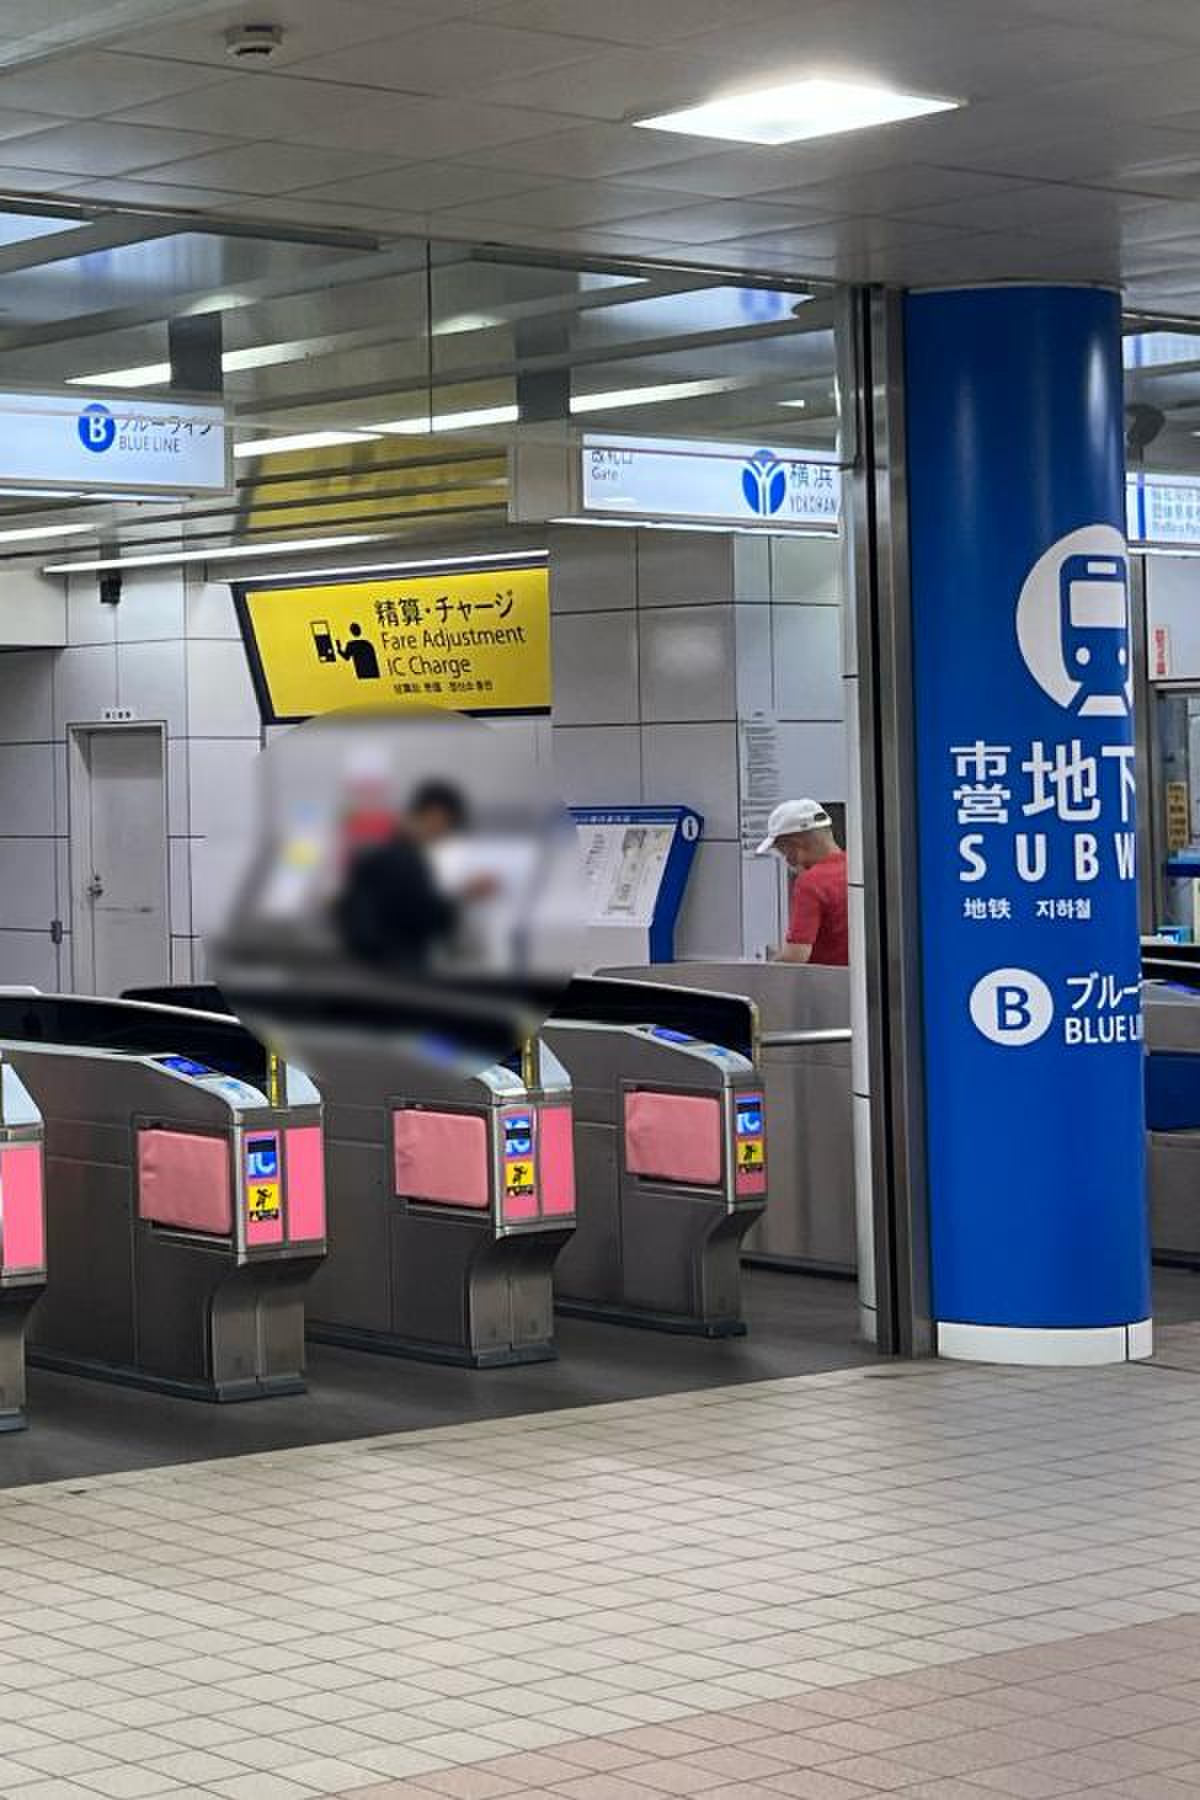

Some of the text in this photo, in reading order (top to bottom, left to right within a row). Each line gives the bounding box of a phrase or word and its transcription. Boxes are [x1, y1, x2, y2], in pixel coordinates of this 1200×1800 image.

[120, 436, 181, 453] BLUE LINE
[591, 467, 619, 481] Gate
[790, 463, 833, 489] 横浜
[381, 626, 527, 652] Fare Adjustment
[387, 655, 472, 679] IC Charge
[963, 898, 1011, 919] 地铁
[1036, 898, 1091, 920] 지하철
[996, 986, 1032, 1031] B
[1065, 1016, 1127, 1044] BLUE
